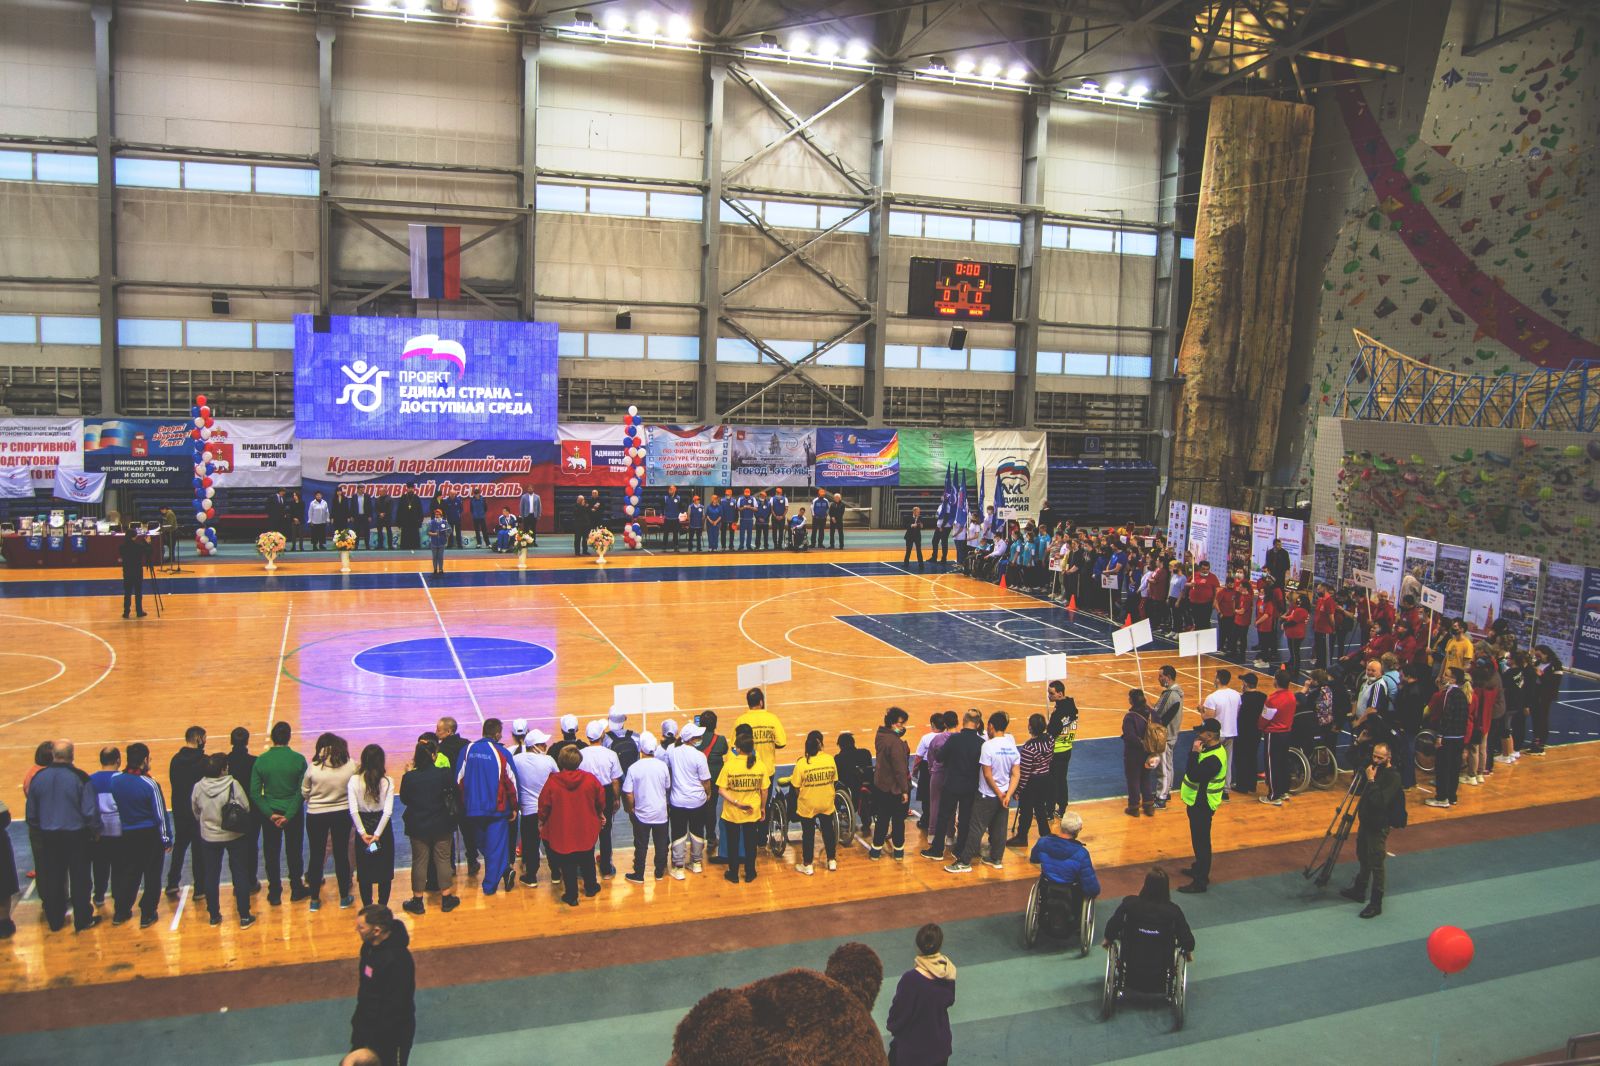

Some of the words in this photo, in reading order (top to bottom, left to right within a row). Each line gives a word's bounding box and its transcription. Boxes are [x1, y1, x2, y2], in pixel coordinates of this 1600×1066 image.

[956, 263, 981, 276] 0:00
[979, 279, 985, 289] 3
[943, 289, 951, 301] 0
[975, 291, 983, 303] 0
[399, 370, 451, 383] ПРОЕКТ
[399, 385, 456, 399] ЕДИНАЯ
[458, 386, 512, 399] СТРАНА
[399, 400, 485, 414] ДОСТУПНАЯ
[488, 402, 533, 415] СРЕДА
[10, 440, 77, 452] СПОРТИВНОЙ
[327, 456, 395, 474] Краевой
[398, 456, 532, 475] паралимпийский
[774, 467, 792, 475] ЭТО
[1004, 496, 1030, 504] ДИНАЯ
